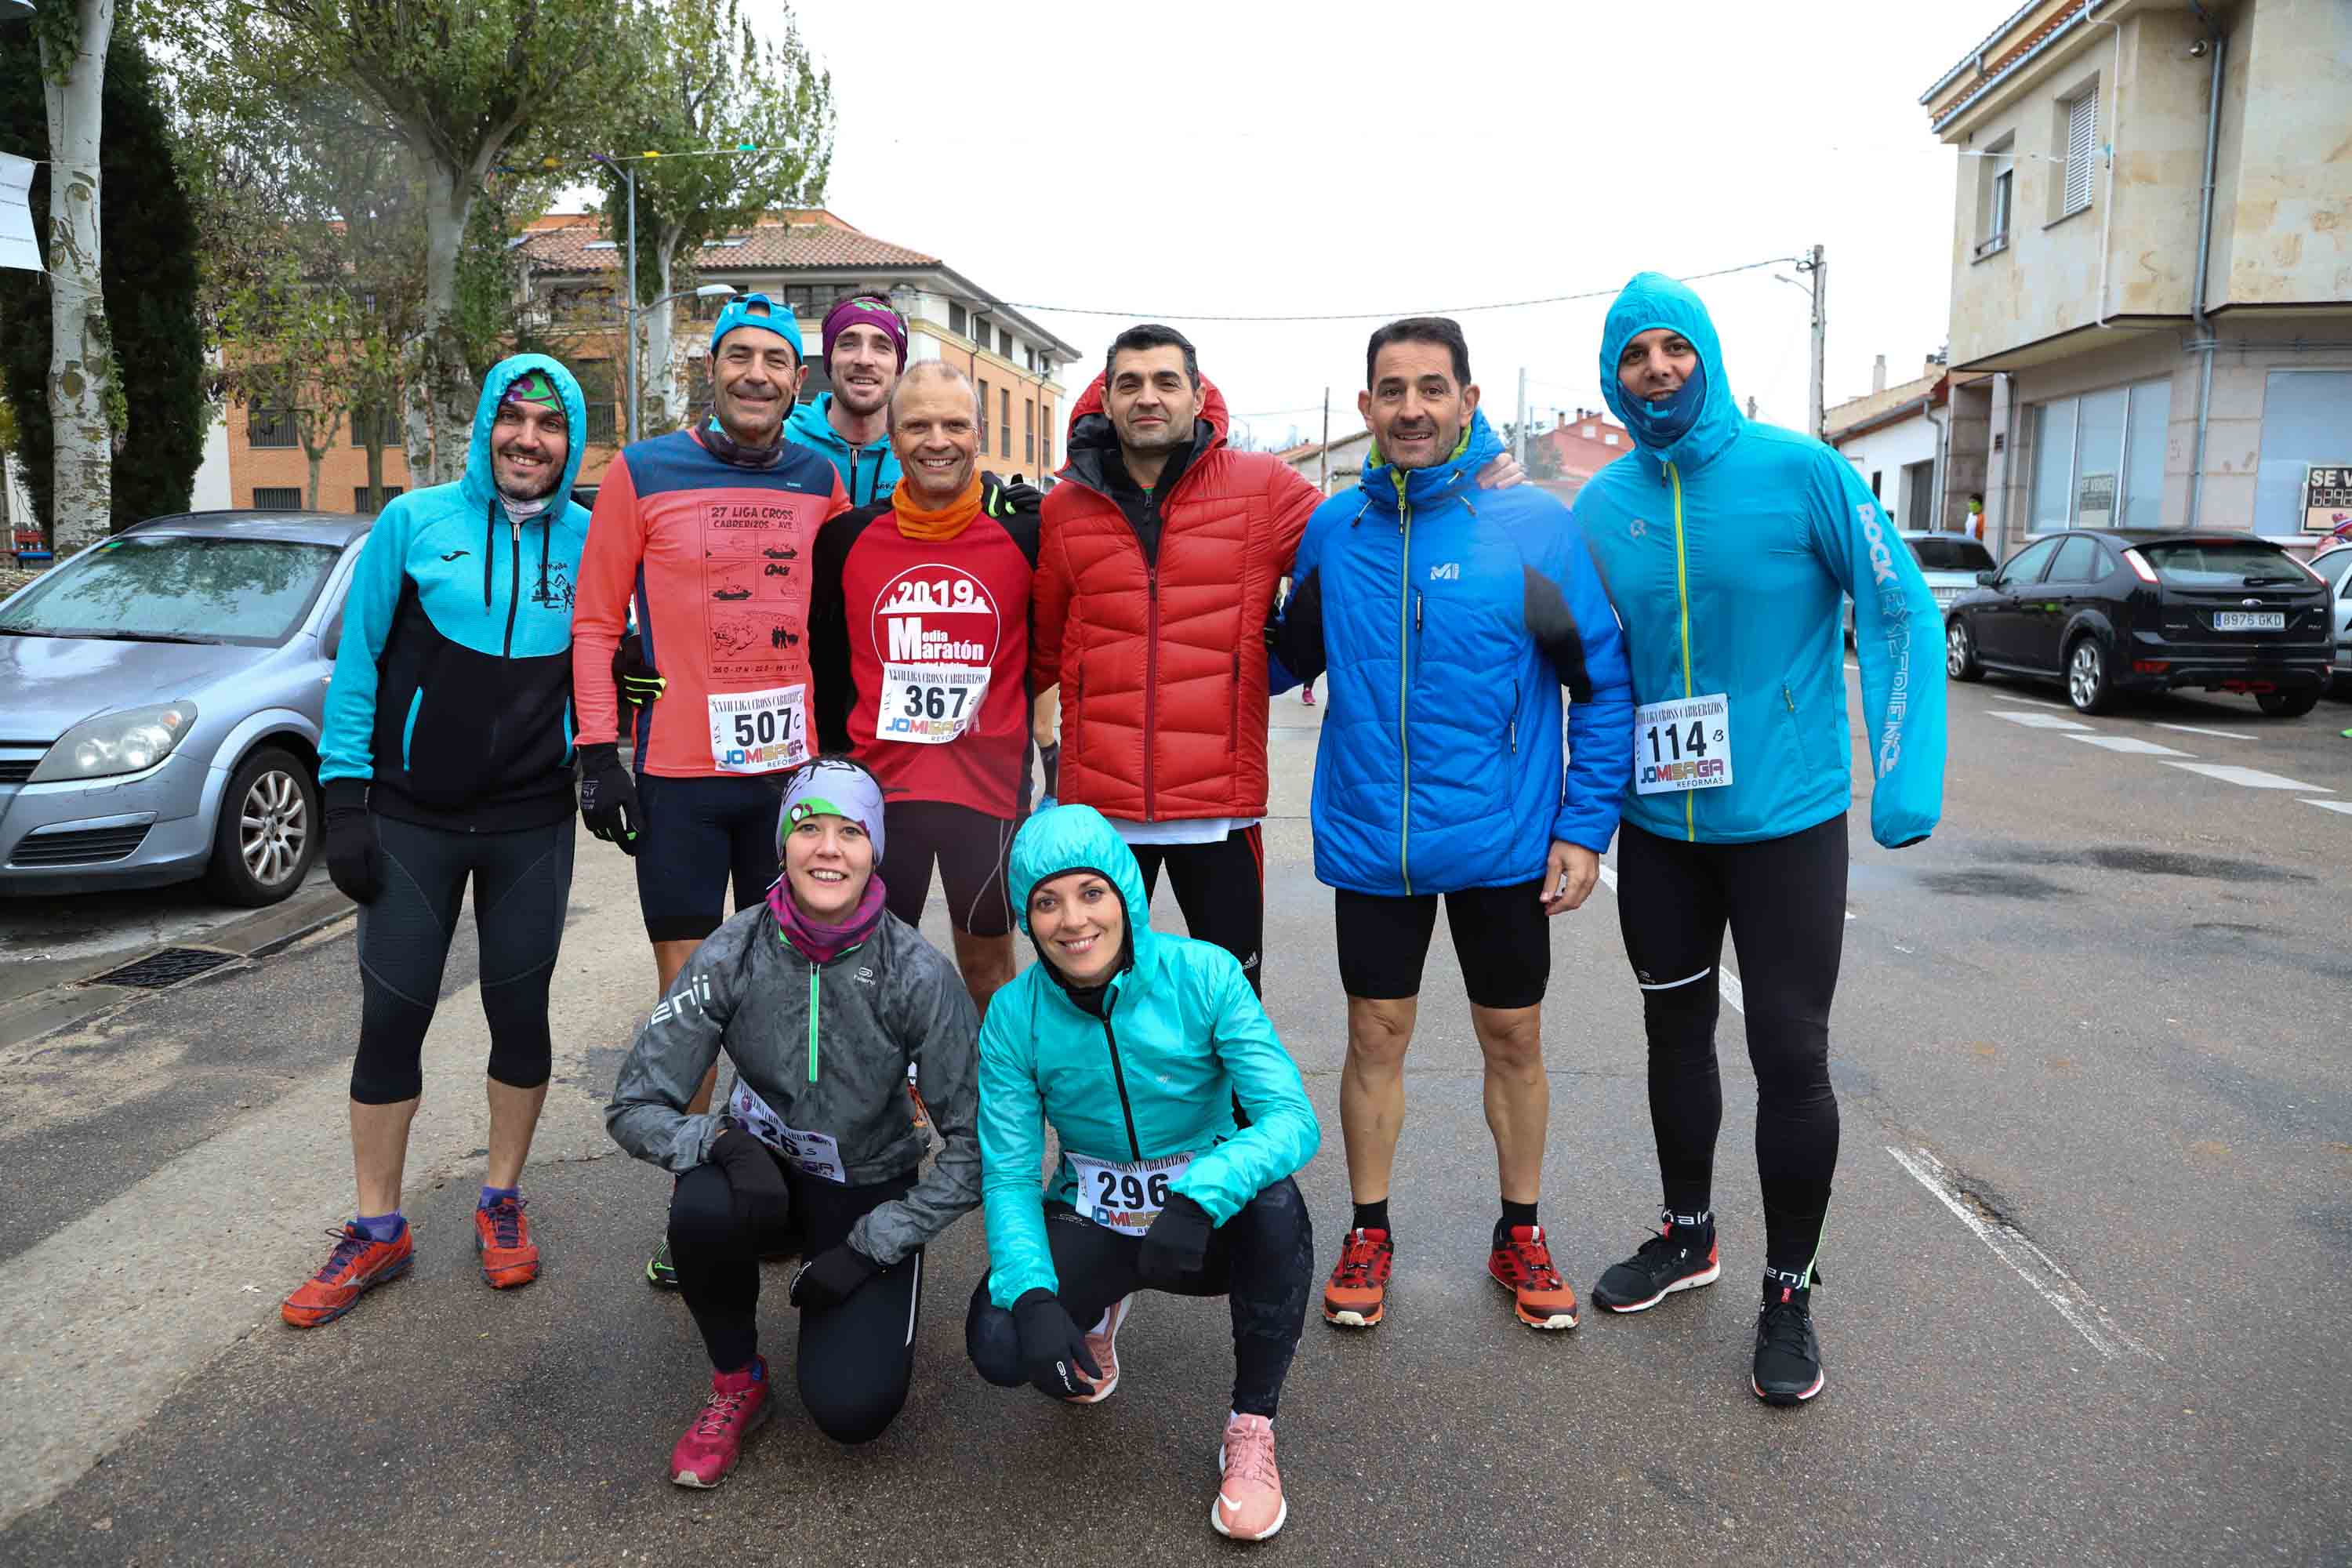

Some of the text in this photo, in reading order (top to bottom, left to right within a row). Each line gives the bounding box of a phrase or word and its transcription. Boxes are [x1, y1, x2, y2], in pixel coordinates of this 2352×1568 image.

[2311, 470, 2336, 487] SE
[711, 507, 793, 521] 27 LIGA CROSS
[1856, 502, 1899, 586] ROCK
[898, 579, 974, 608] 2019
[2259, 614, 2281, 626] GKD
[922, 672, 944, 684] CROSS
[752, 696, 772, 710] CROSS
[903, 684, 968, 720] 367
[735, 707, 792, 747] 507
[885, 717, 966, 735] JOMISAG
[1646, 720, 1707, 763] 114
[1712, 729, 1724, 742] B
[1676, 777, 1725, 789] REFORMAS
[1098, 1171, 1169, 1210] 296
